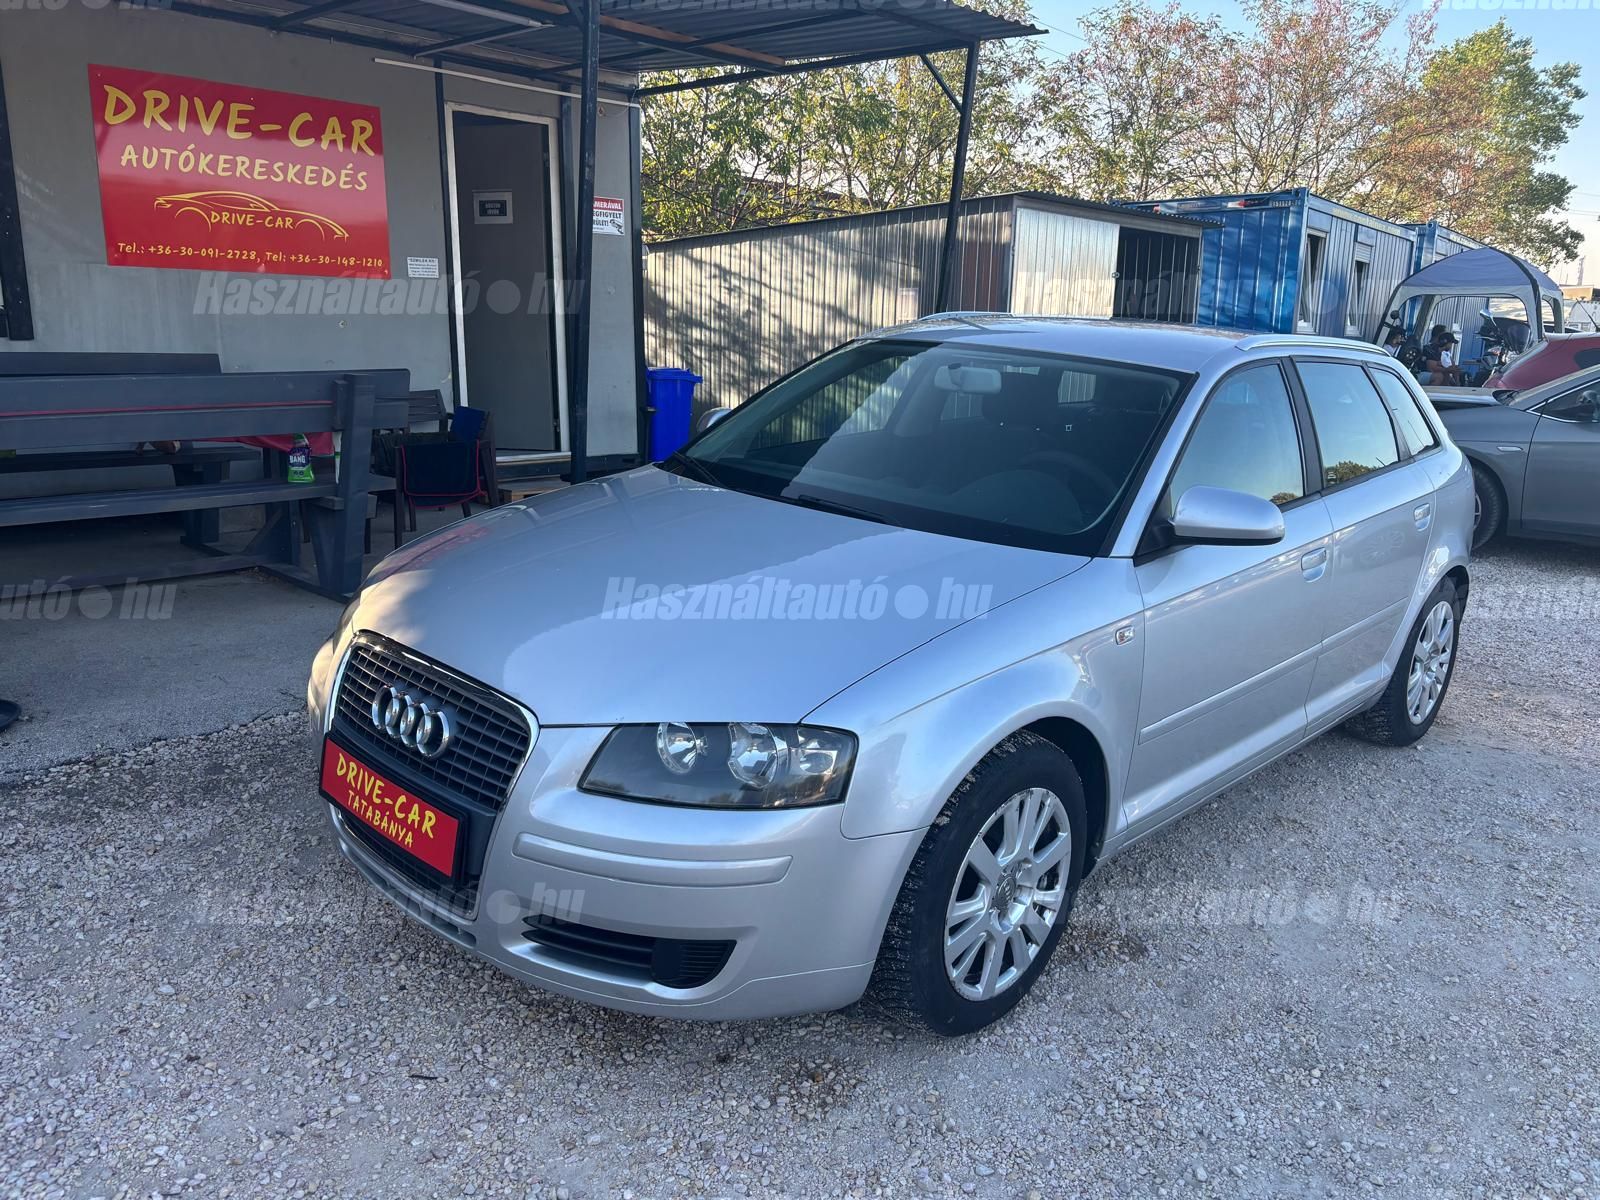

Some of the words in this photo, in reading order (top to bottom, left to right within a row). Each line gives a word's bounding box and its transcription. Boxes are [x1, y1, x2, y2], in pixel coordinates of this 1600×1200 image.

[103, 84, 376, 157] DRIVE-CAR
[120, 143, 369, 191] AUTÓKERESKEDÉS
[210, 211, 294, 229] DRIVE-CAR
[148, 245, 260, 263] +36-30-091-2728,
[265, 251, 286, 262] Tel:
[290, 254, 383, 266] +36-30-148-1210
[289, 455, 306, 464] BANG
[336, 753, 436, 839] DRIVE-CAR
[347, 790, 413, 848] TATABÁNYA
